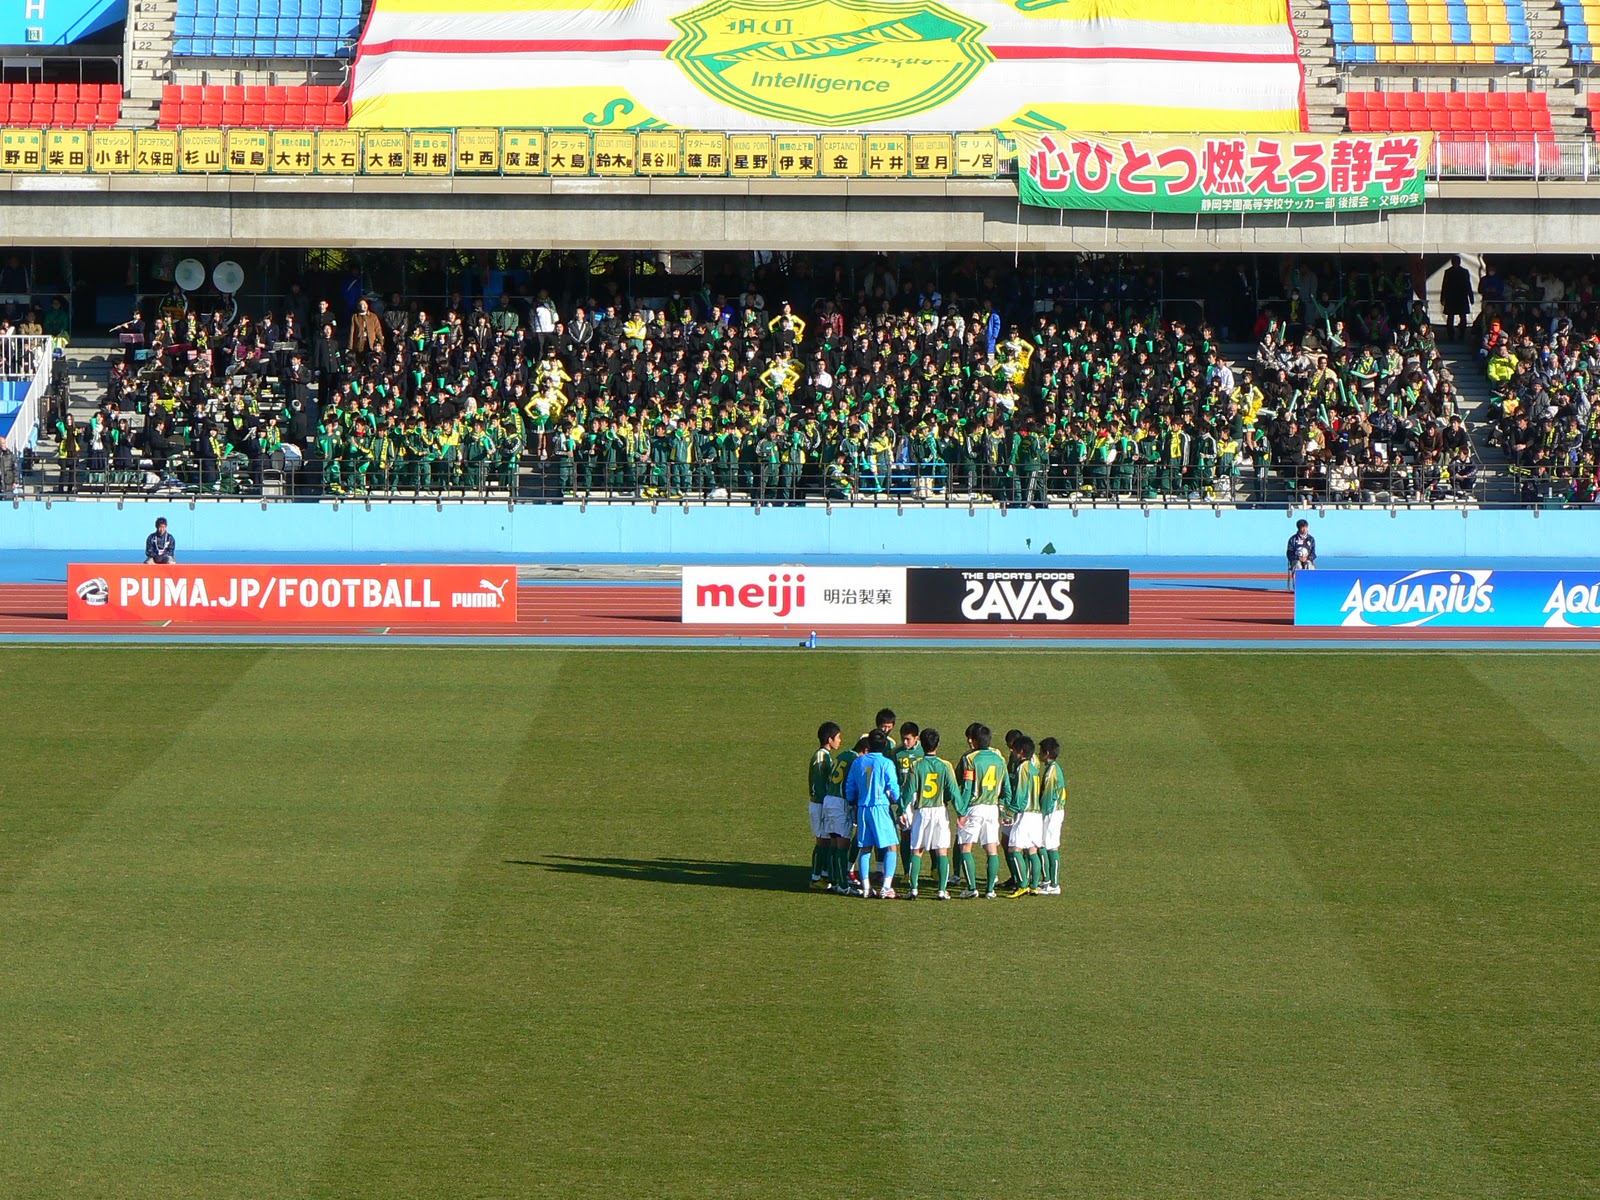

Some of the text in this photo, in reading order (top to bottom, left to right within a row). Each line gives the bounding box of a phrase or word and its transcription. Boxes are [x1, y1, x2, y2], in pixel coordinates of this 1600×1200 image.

[25, 0, 46, 19] H
[1294, 10, 1307, 19] 24
[1526, 12, 1539, 20] 24
[141, 22, 155, 31] 23
[1297, 29, 1310, 39] 23
[1530, 31, 1544, 40] 23
[138, 41, 152, 50] 22
[1299, 48, 1312, 58] 22
[1534, 50, 1548, 59] 22
[750, 71, 891, 94] Intelligence
[551, 140, 586, 149] クラッキ
[4, 150, 40, 164] 野田
[49, 151, 84, 165] 柴田
[95, 150, 130, 165] 小針
[138, 151, 173, 166] 久保田
[185, 150, 220, 165] 杉山
[230, 150, 265, 165] 福島
[276, 151, 311, 167] 大村
[321, 152, 356, 167] 大石
[369, 152, 403, 167] 大橋
[413, 152, 447, 167] 利根
[460, 151, 494, 165] 中西
[551, 153, 585, 168] 大島
[641, 152, 677, 168] 長谷川
[687, 153, 722, 168] 篠原
[734, 154, 768, 169] 星野
[780, 155, 814, 170] 伊東
[833, 154, 849, 169] 金
[869, 155, 904, 170] 片井
[915, 155, 948, 170] 望月
[959, 153, 994, 168] 一ノ宮
[1028, 135, 1420, 195] 心ひとつ燃えろ静学
[1201, 198, 1335, 211] 静岡学園高等学校サッカー部
[120, 577, 440, 609] PUMA.JP/FOOTBALL
[452, 592, 498, 608] PUMA
[697, 574, 805, 617] meiji
[823, 589, 893, 605] 明治製菓
[961, 580, 1075, 621] SAVAS
[982, 766, 997, 790] 4
[923, 774, 938, 798] 5
